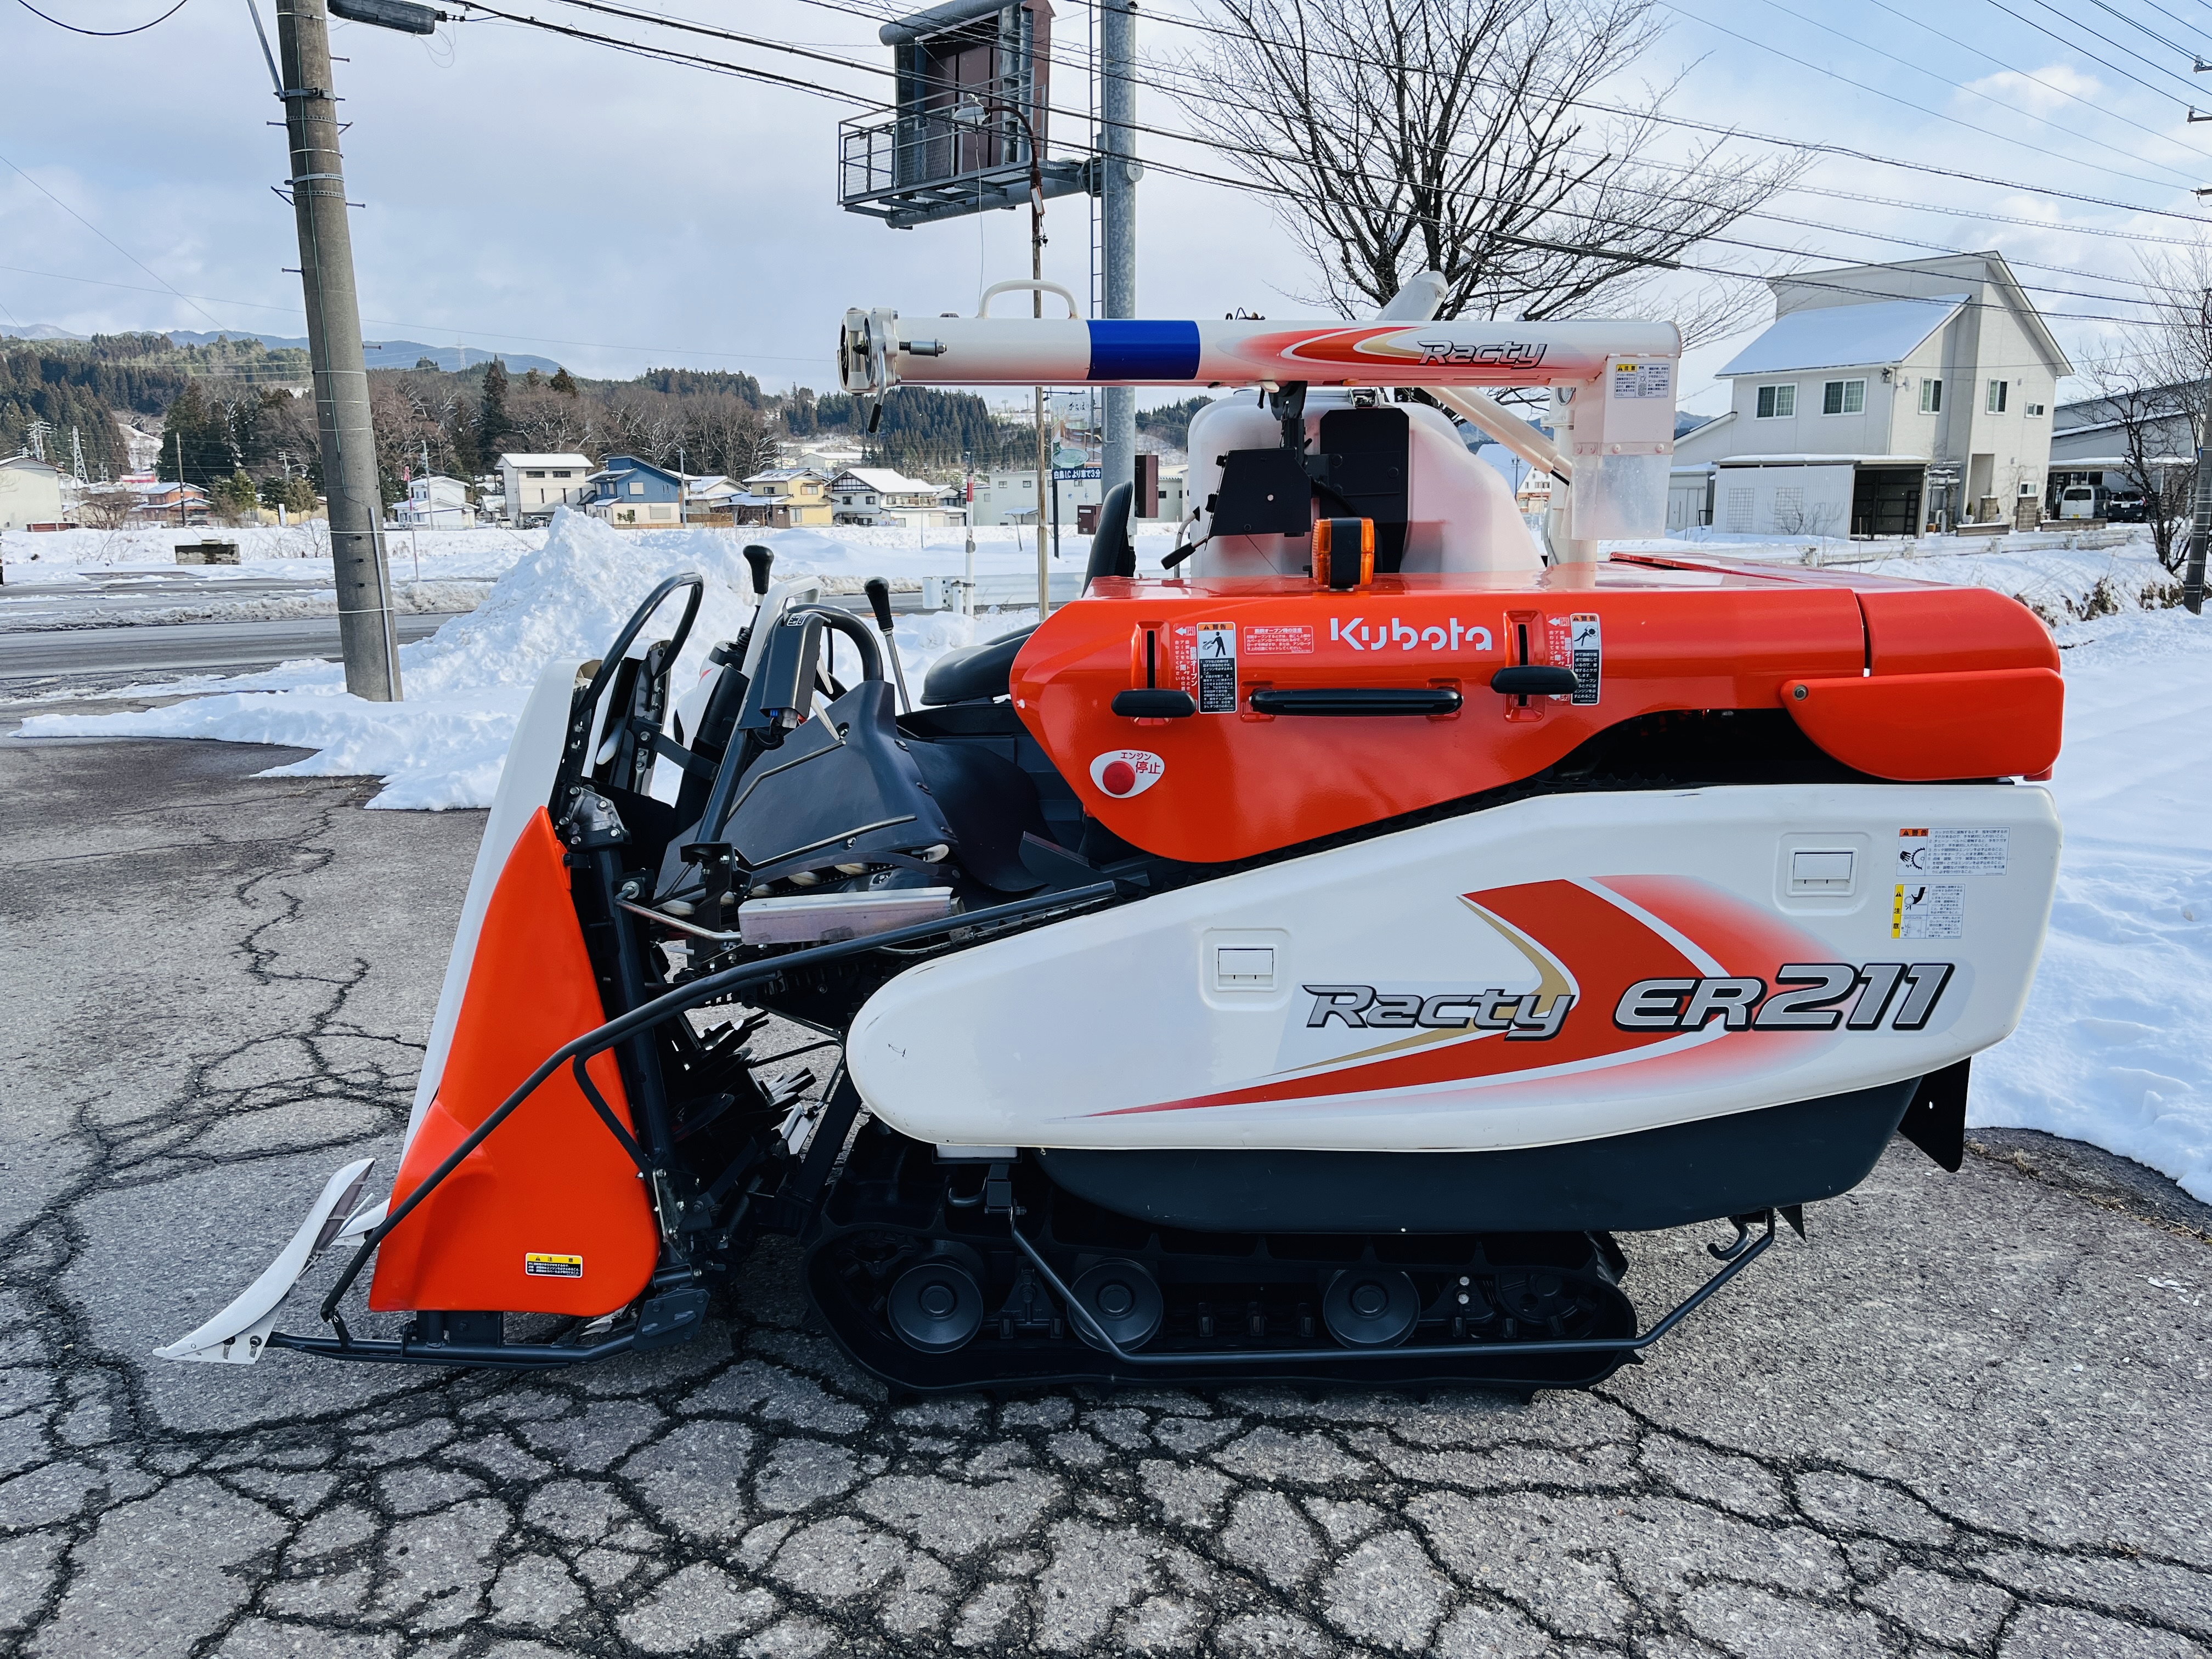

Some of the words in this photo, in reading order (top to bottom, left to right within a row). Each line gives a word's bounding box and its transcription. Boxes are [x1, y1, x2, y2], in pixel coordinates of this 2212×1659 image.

[1417, 340, 1547, 369] Racty
[1330, 618, 1492, 650] Kubota
[1120, 752, 1151, 760] エンジン
[1136, 761, 1160, 774] 停止
[1301, 984, 1576, 1041] Racty
[1612, 963, 1955, 1032] ER211
